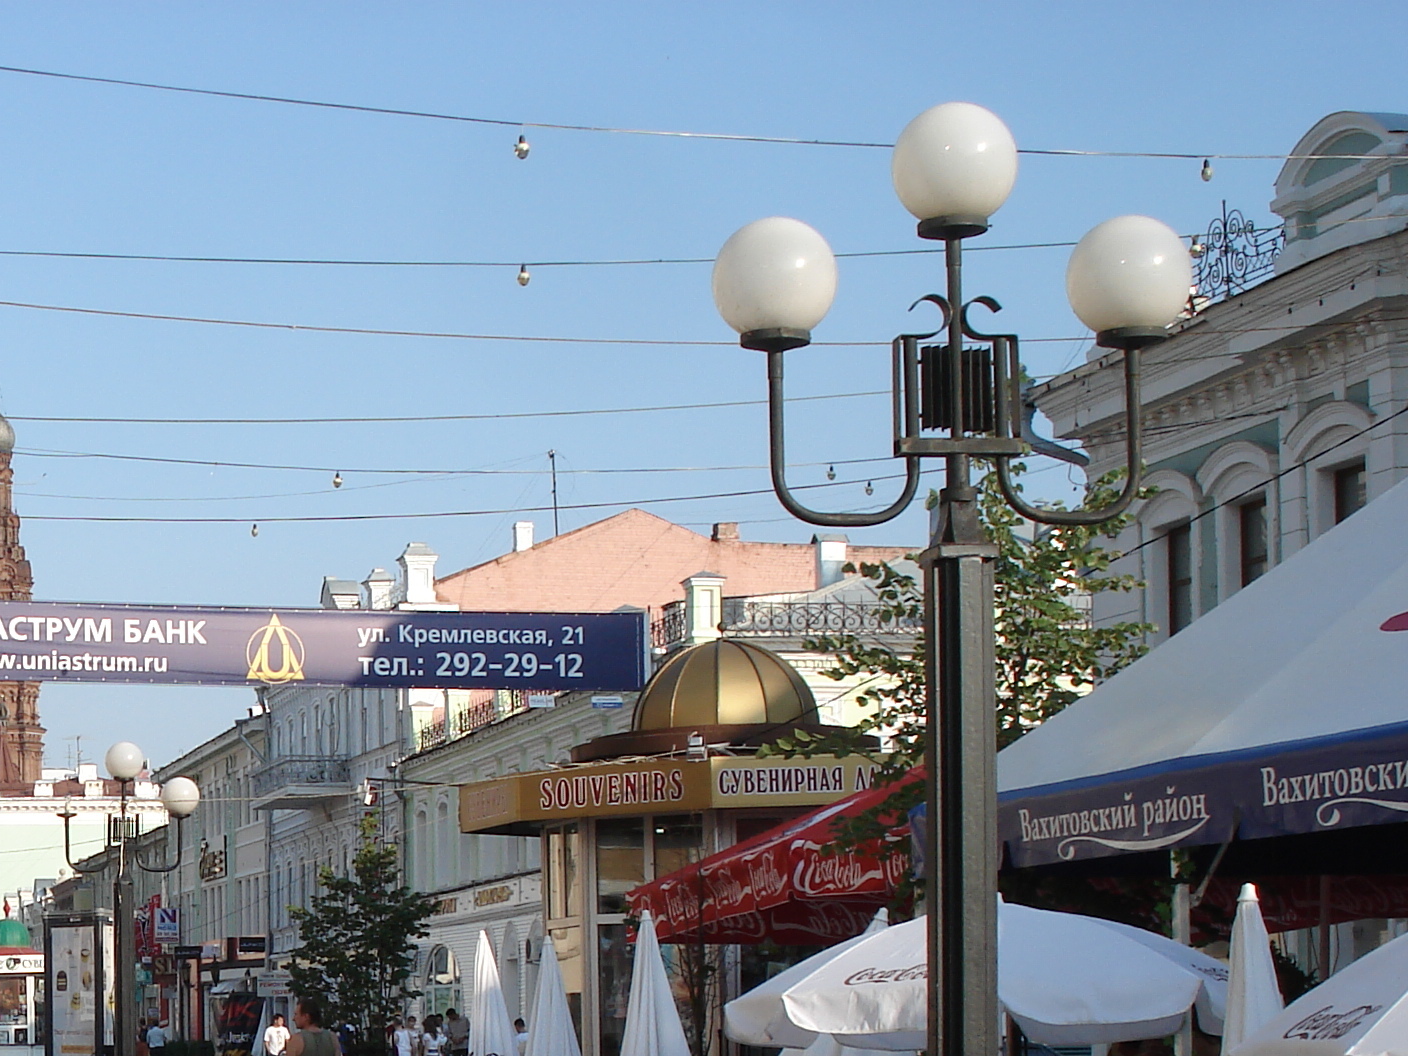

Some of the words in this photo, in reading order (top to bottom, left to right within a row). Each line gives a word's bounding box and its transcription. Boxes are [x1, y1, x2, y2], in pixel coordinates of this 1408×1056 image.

[123, 619, 208, 645] БАНК
[357, 625, 391, 648] ул.
[398, 623, 554, 647] Кремлевская,
[561, 626, 586, 645] 21
[357, 655, 425, 677] тел.:
[435, 651, 585, 678] 292-29-12
[540, 769, 685, 810] SOUVENIRS
[718, 765, 844, 796] СУВЕНИРНАЯ
[1018, 791, 1138, 843] Вахитовский
[1142, 785, 1208, 837] район
